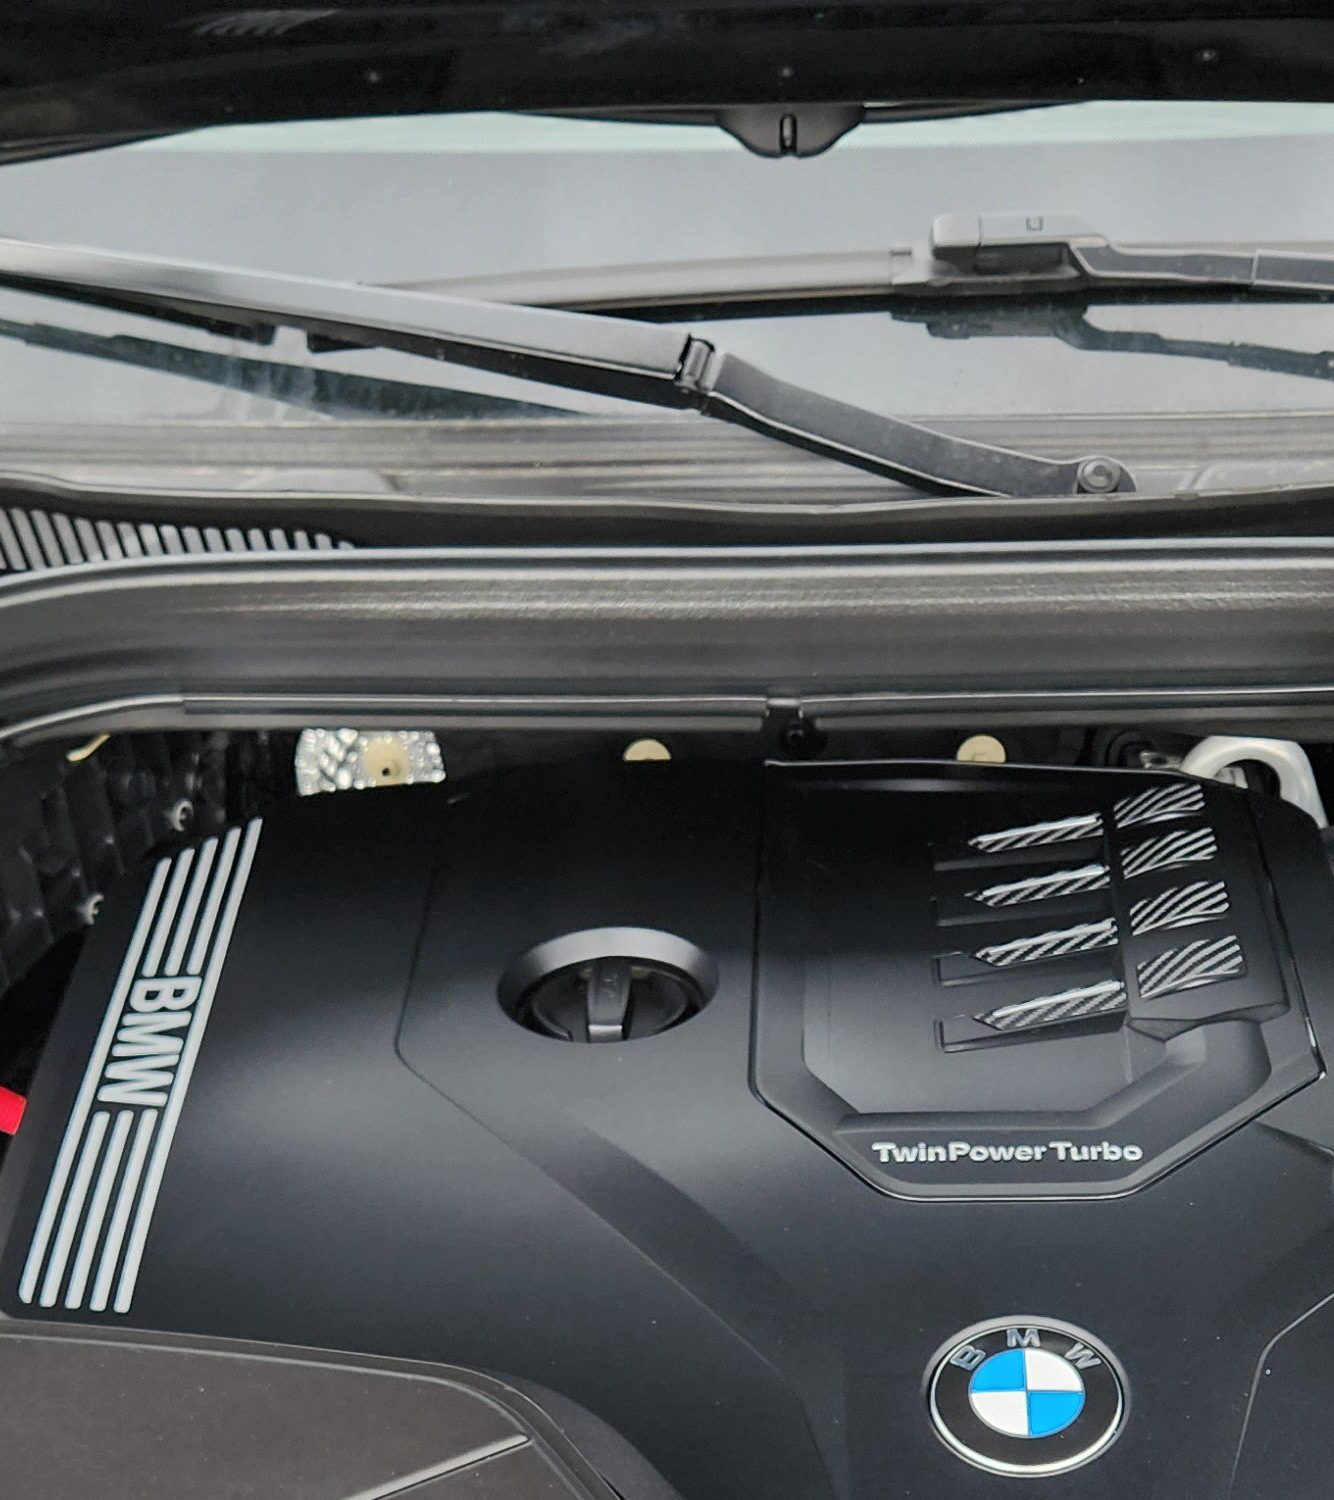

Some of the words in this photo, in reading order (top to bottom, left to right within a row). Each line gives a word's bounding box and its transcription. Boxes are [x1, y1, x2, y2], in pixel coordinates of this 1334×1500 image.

[97, 976, 202, 1107] BMW
[871, 1141, 1047, 1163] TwinPower
[1049, 1140, 1143, 1162] Turbo
[949, 1328, 1102, 1371] BMW
